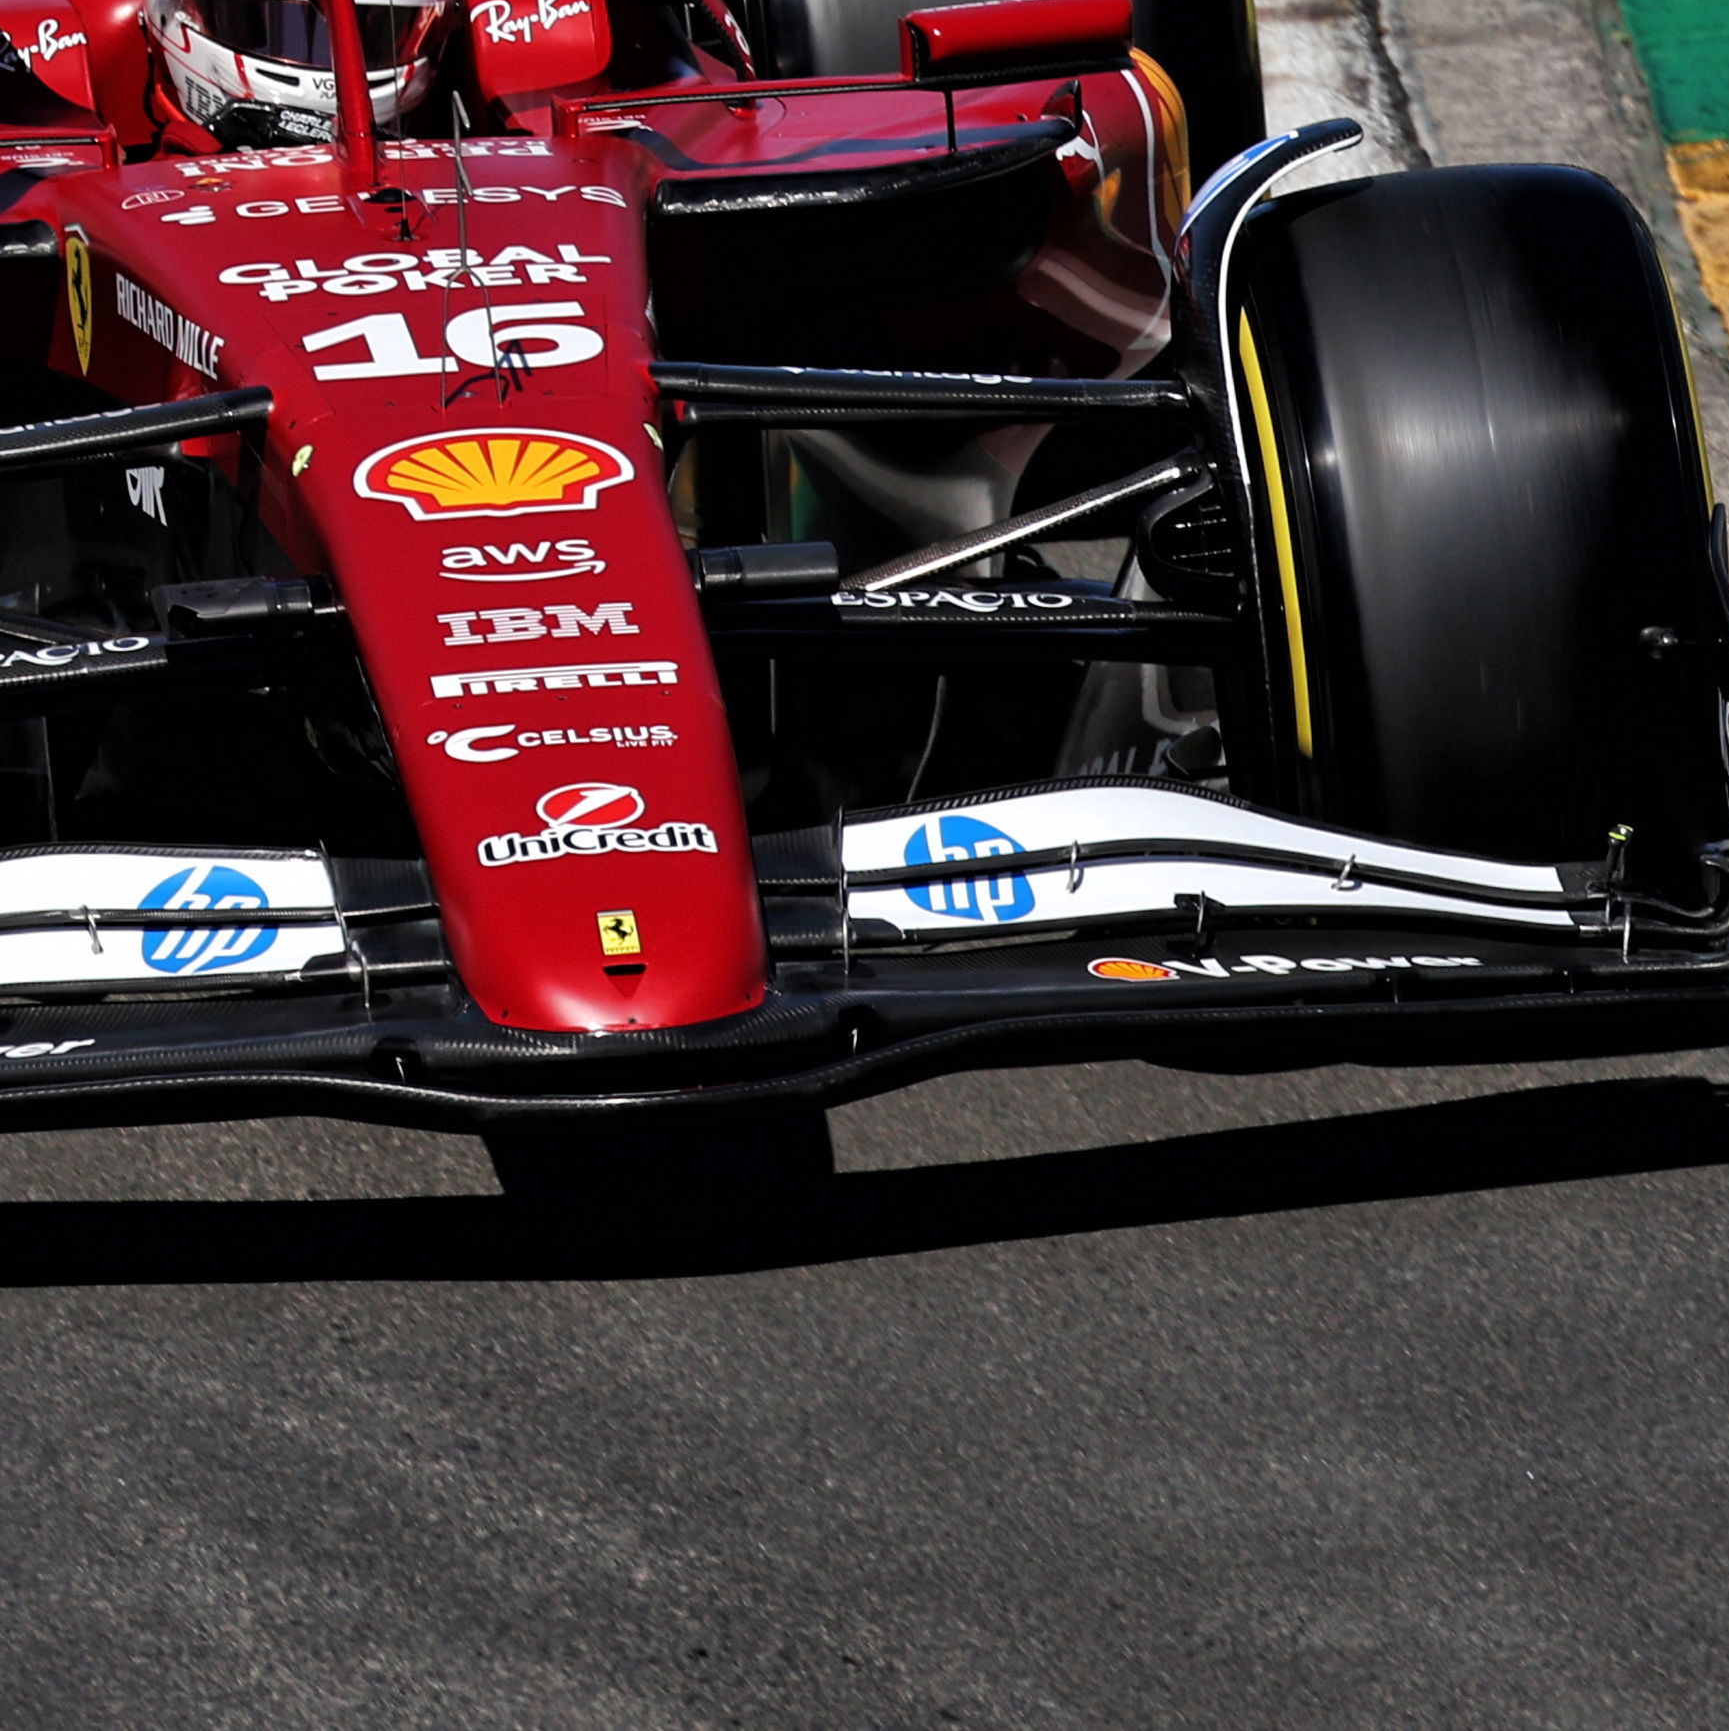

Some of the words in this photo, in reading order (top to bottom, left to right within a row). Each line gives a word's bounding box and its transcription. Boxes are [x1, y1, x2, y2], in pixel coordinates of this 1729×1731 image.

[312, 77, 337, 91] VG
[278, 120, 334, 143] LECLER
[280, 109, 333, 131] CHARLE
[236, 185, 627, 218] GEESYS
[219, 243, 612, 284] GLOBAL
[259, 263, 588, 302] POKER
[115, 272, 174, 352] RICHARD
[175, 314, 225, 381] MILLE
[301, 301, 604, 381] 16
[440, 538, 596, 569] aws
[437, 602, 640, 647] IBM
[429, 661, 679, 699] PIRELLI
[616, 739, 647, 749] LIVE
[651, 738, 675, 748] FIT
[480, 824, 717, 864] UniCredit
[925, 817, 1016, 924] hp
[150, 865, 264, 974] hp
